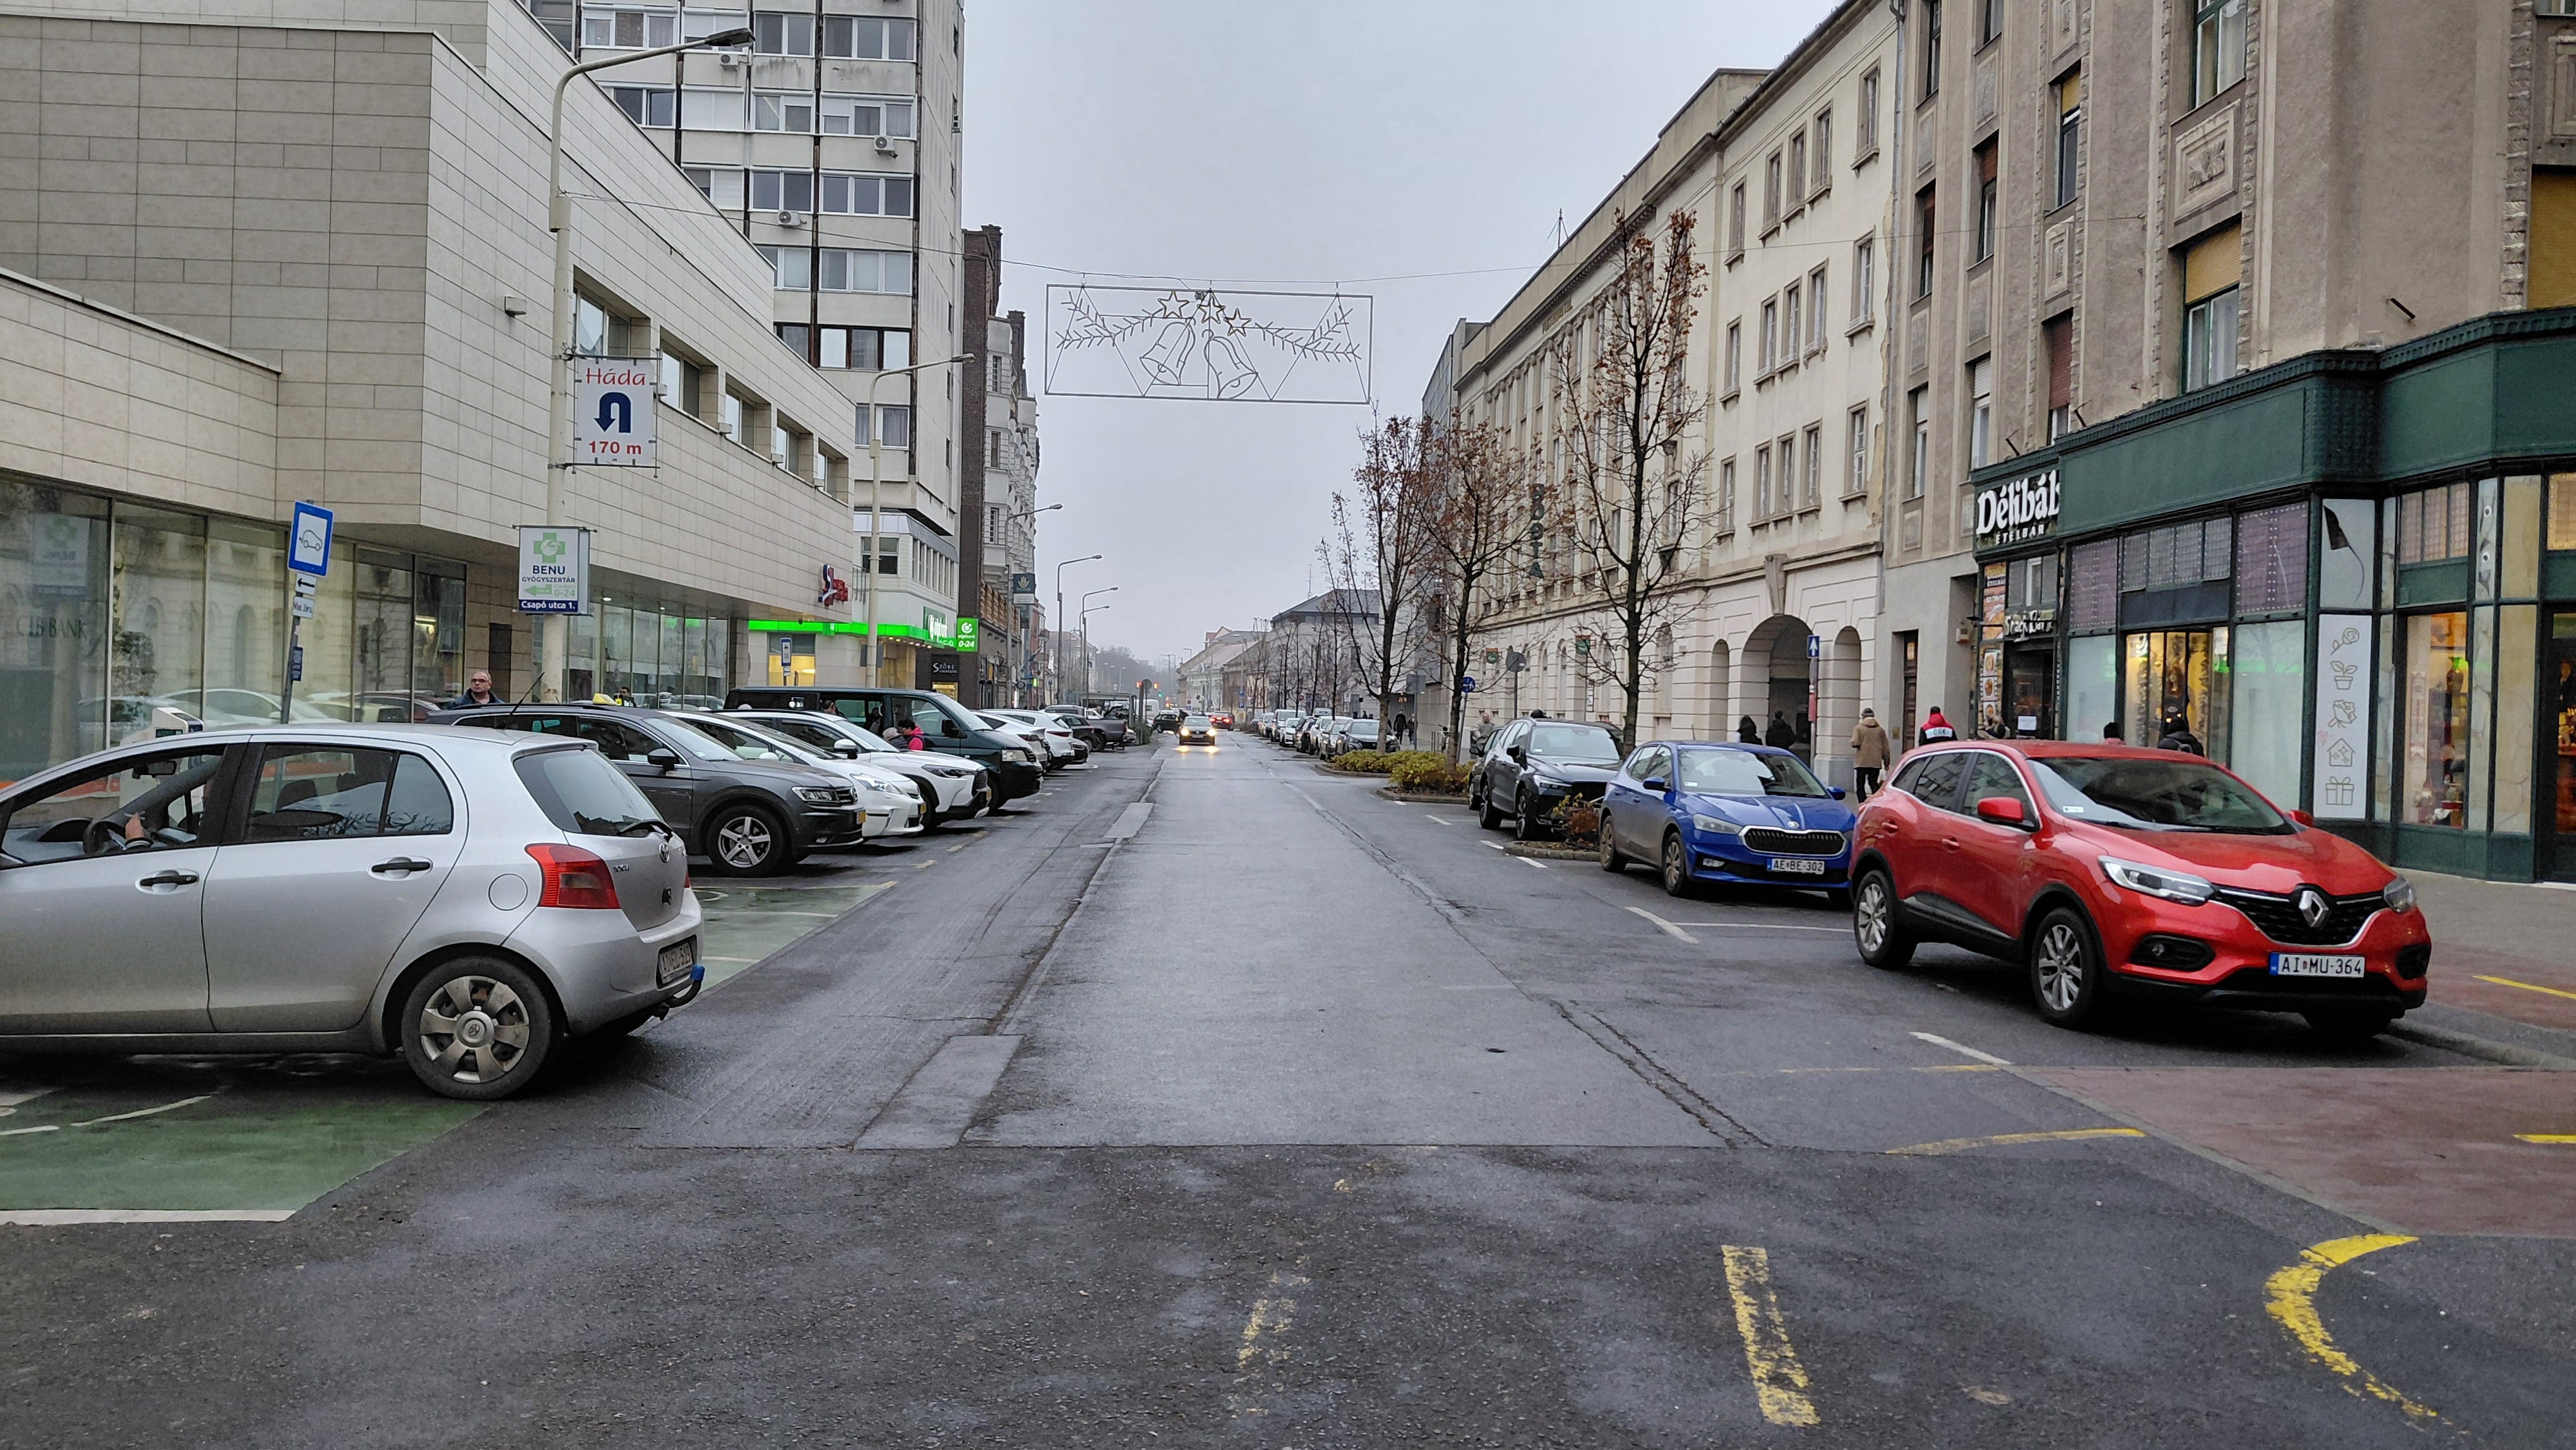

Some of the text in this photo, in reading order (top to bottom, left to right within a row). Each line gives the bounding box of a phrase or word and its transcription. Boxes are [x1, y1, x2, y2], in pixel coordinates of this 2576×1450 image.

[586, 368, 647, 385] Háda
[589, 441, 641, 454] 170 m
[1996, 523, 2044, 545] ÉTELBÁR
[532, 565, 565, 575] BENU
[521, 601, 547, 609] Csapó
[1774, 860, 1786, 870] AE
[2282, 957, 2361, 974] AI MU-364
